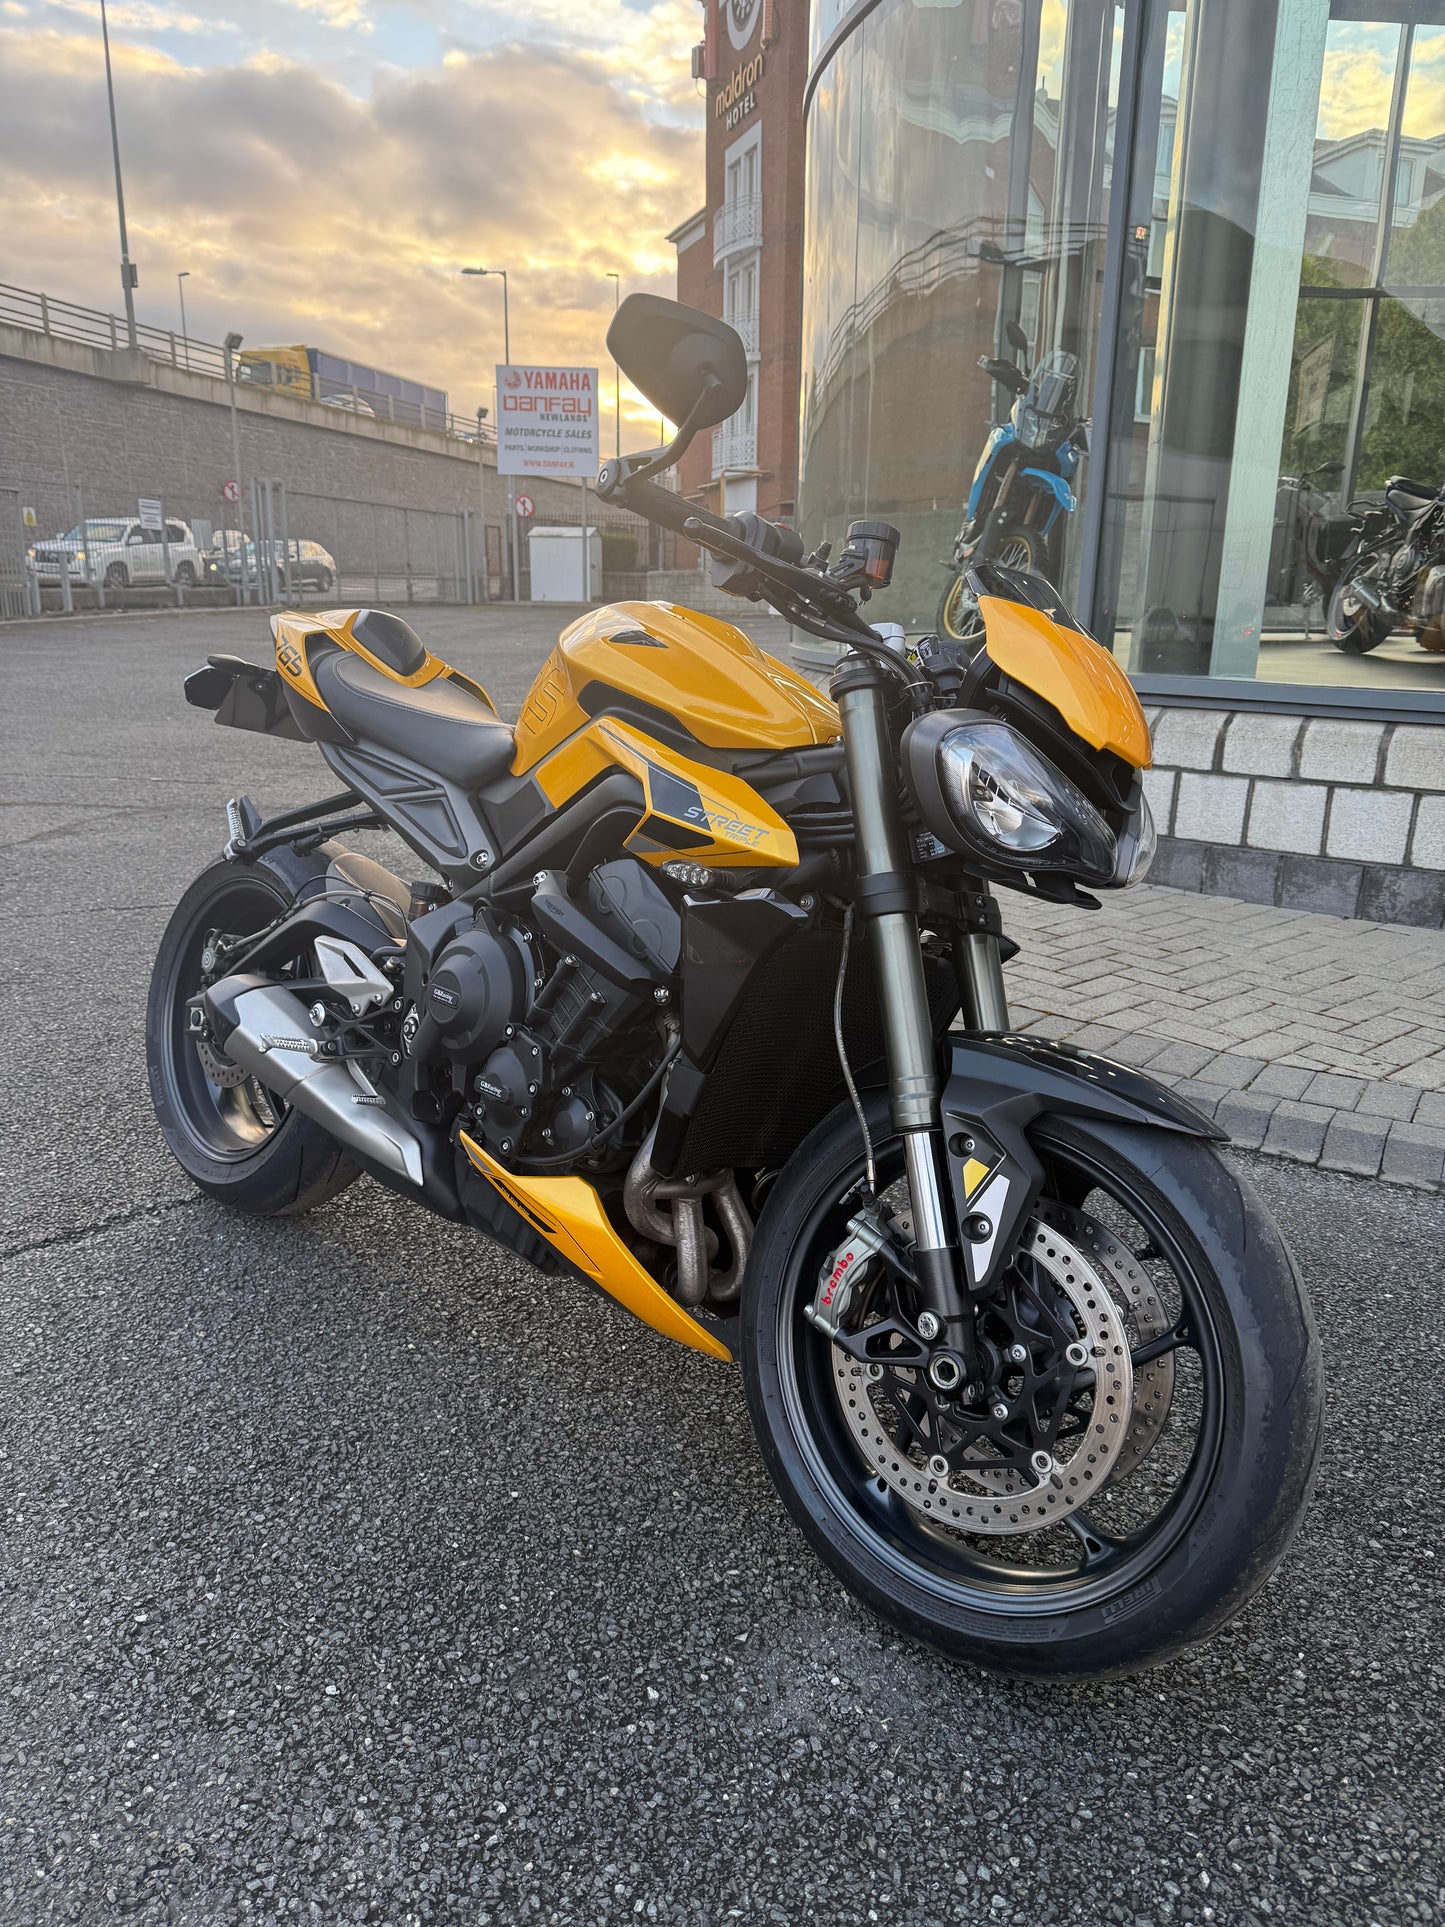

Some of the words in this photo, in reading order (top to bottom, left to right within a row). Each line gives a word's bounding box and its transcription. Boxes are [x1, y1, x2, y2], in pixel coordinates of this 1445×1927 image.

[716, 53, 763, 118] maldron
[726, 92, 755, 131] HOTEL
[523, 371, 592, 391] YAMAHA
[505, 427, 563, 438] MOTORCYCLE
[564, 429, 592, 439] SALES
[540, 413, 588, 423] NEWLANDS
[504, 444, 524, 452] PARTS
[527, 445, 561, 453] WORKSHOP
[563, 446, 593, 454] CLOTHING
[277, 634, 303, 678] 765
[683, 806, 770, 840] STREET
[724, 831, 760, 848] TRIPLE
[821, 1252, 854, 1306] brembo
[1100, 1576, 1165, 1625] PIRELLI
